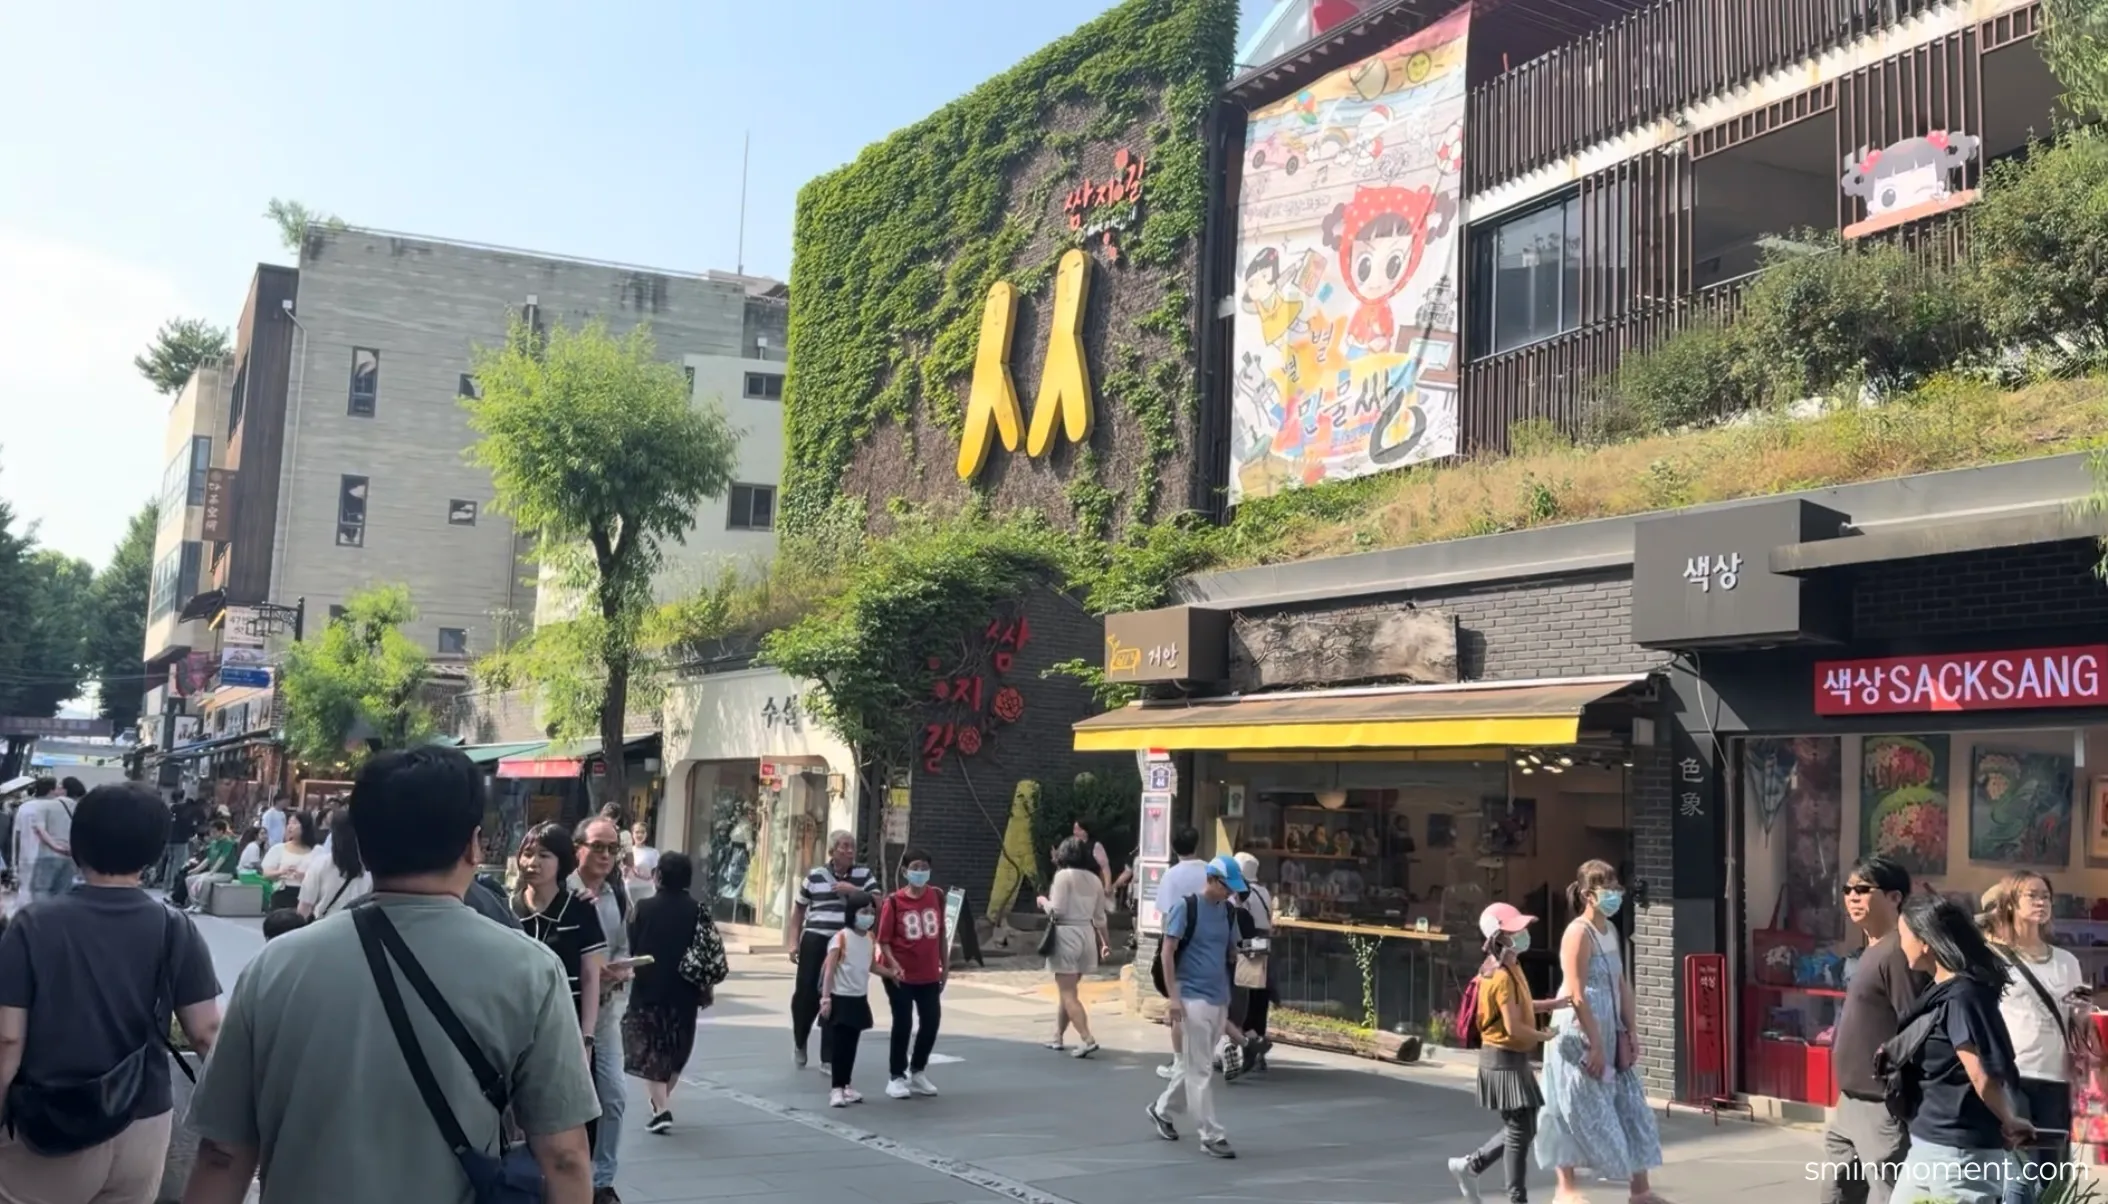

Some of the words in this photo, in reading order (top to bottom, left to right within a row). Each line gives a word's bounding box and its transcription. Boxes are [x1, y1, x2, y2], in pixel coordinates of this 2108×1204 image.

[1683, 552, 1742, 592] 색상
[1148, 642, 1179, 669] 거안
[1823, 666, 1886, 706] 색상
[1889, 654, 2099, 703] SACKSANG
[1677, 757, 1705, 817] 色象
[903, 908, 940, 940] 88
